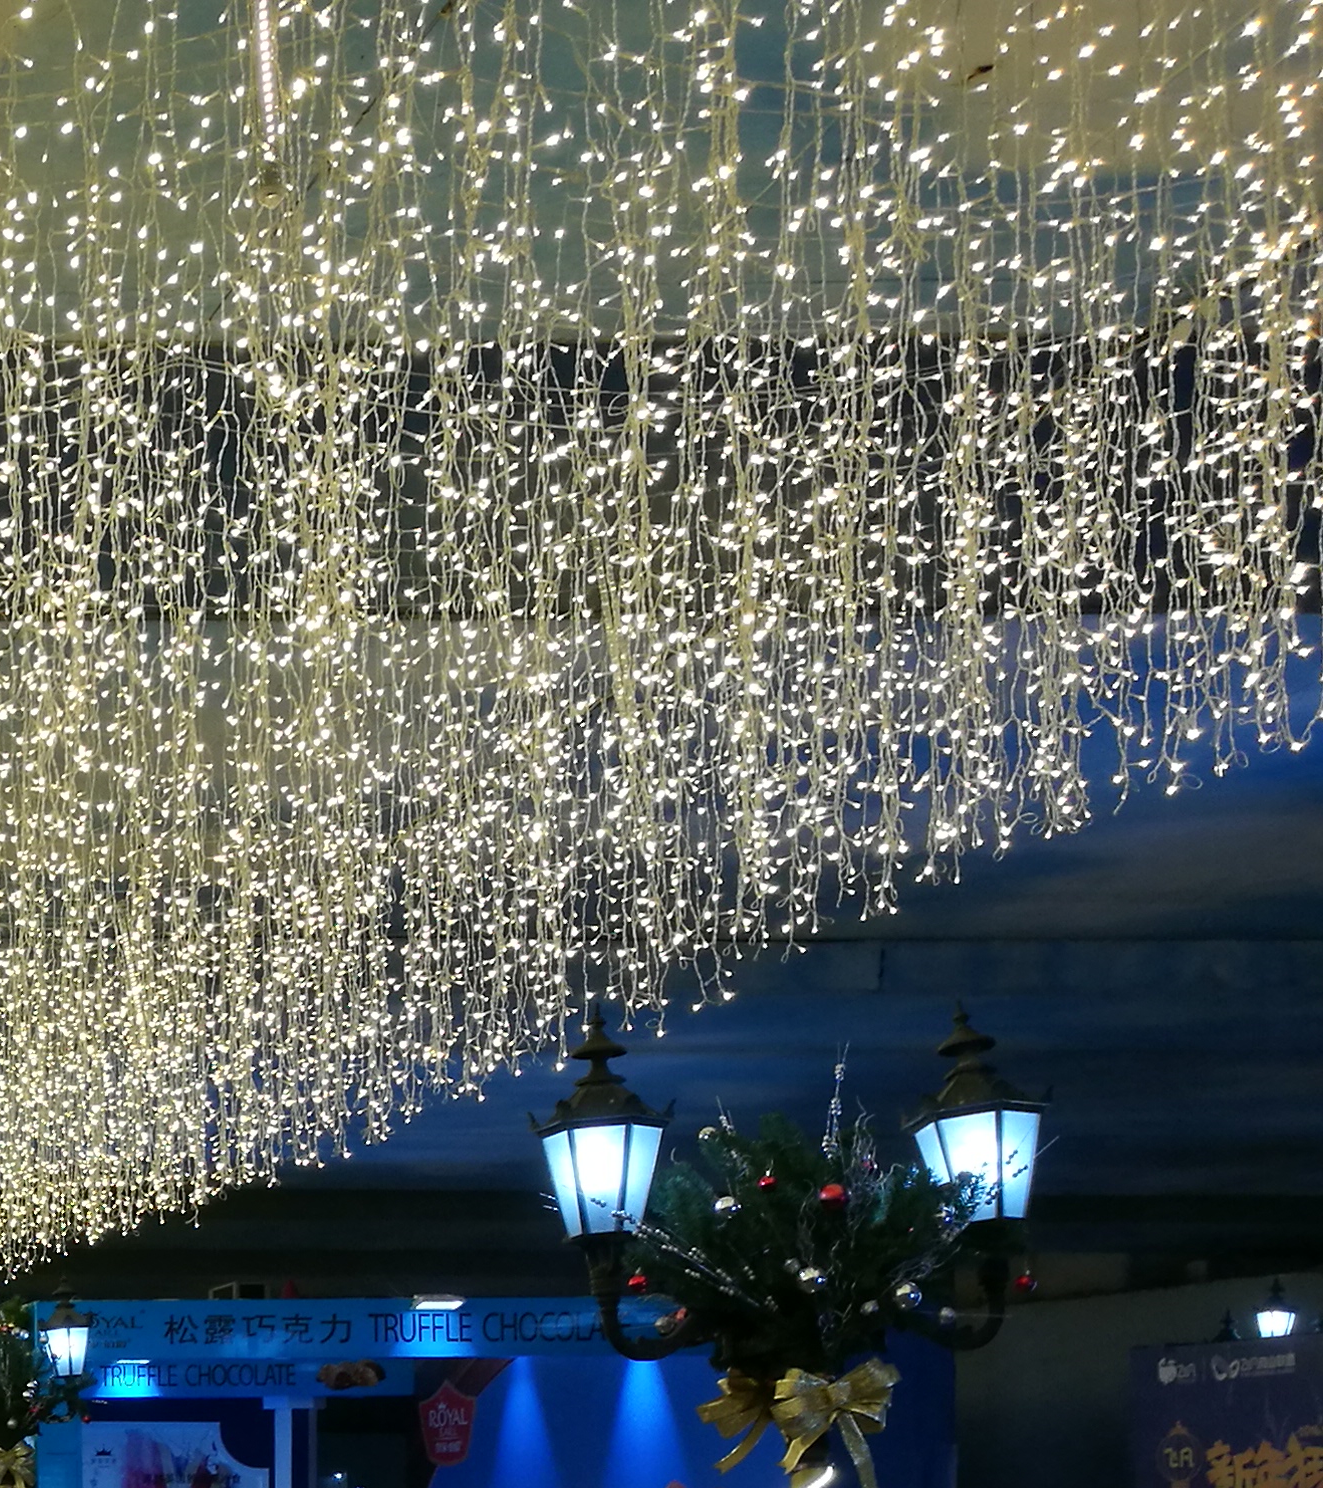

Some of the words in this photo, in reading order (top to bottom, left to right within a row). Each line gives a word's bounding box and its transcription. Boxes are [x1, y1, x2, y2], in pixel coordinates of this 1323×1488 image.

[163, 1312, 353, 1345] 松露巧克力
[369, 1312, 472, 1342] TRUFFLE
[482, 1311, 632, 1343] CHOCOLA
[101, 1363, 178, 1388] TRUFFLE
[184, 1363, 297, 1387] CHOCOLATE
[428, 1407, 468, 1428] ROYAL
